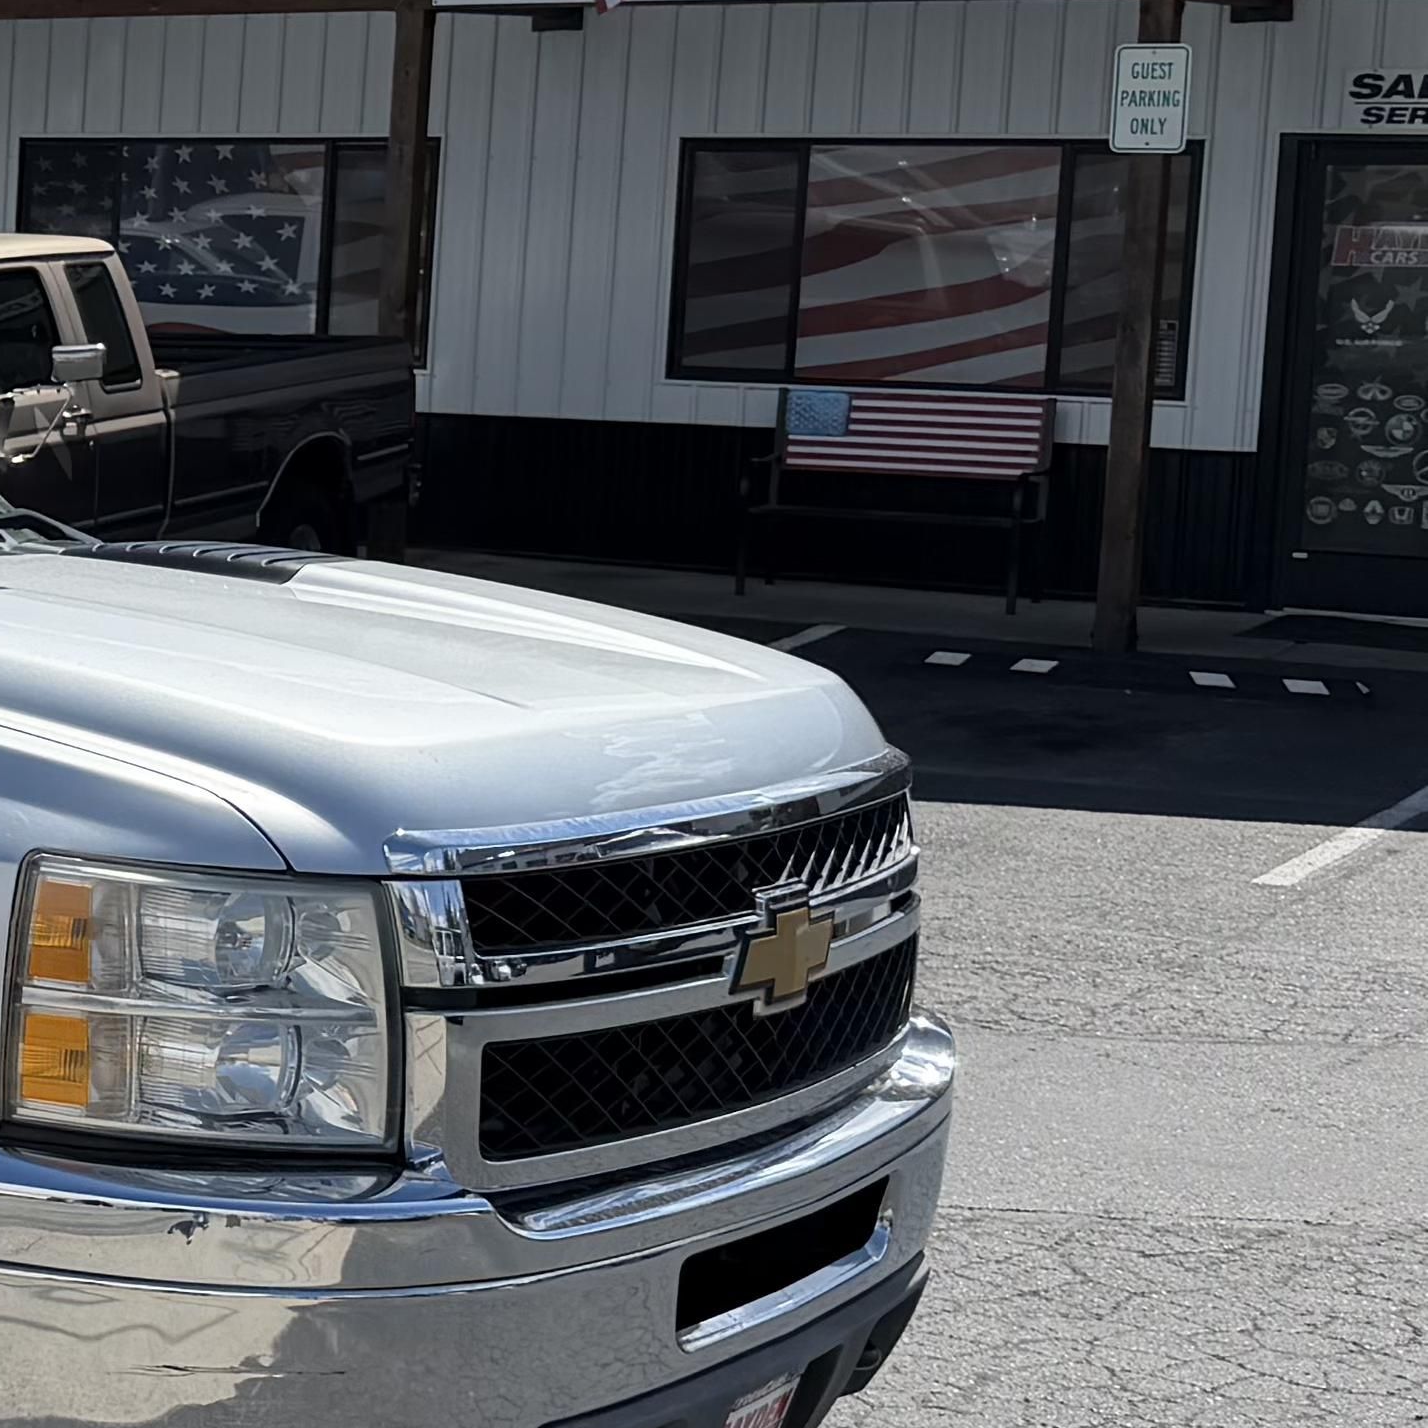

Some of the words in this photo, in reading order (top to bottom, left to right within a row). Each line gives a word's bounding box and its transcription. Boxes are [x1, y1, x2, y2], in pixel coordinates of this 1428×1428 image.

[1131, 62, 1174, 80] GUEST
[1120, 90, 1181, 108] PARKING
[1129, 117, 1167, 135] ONLY
[1370, 251, 1419, 265] CARS
